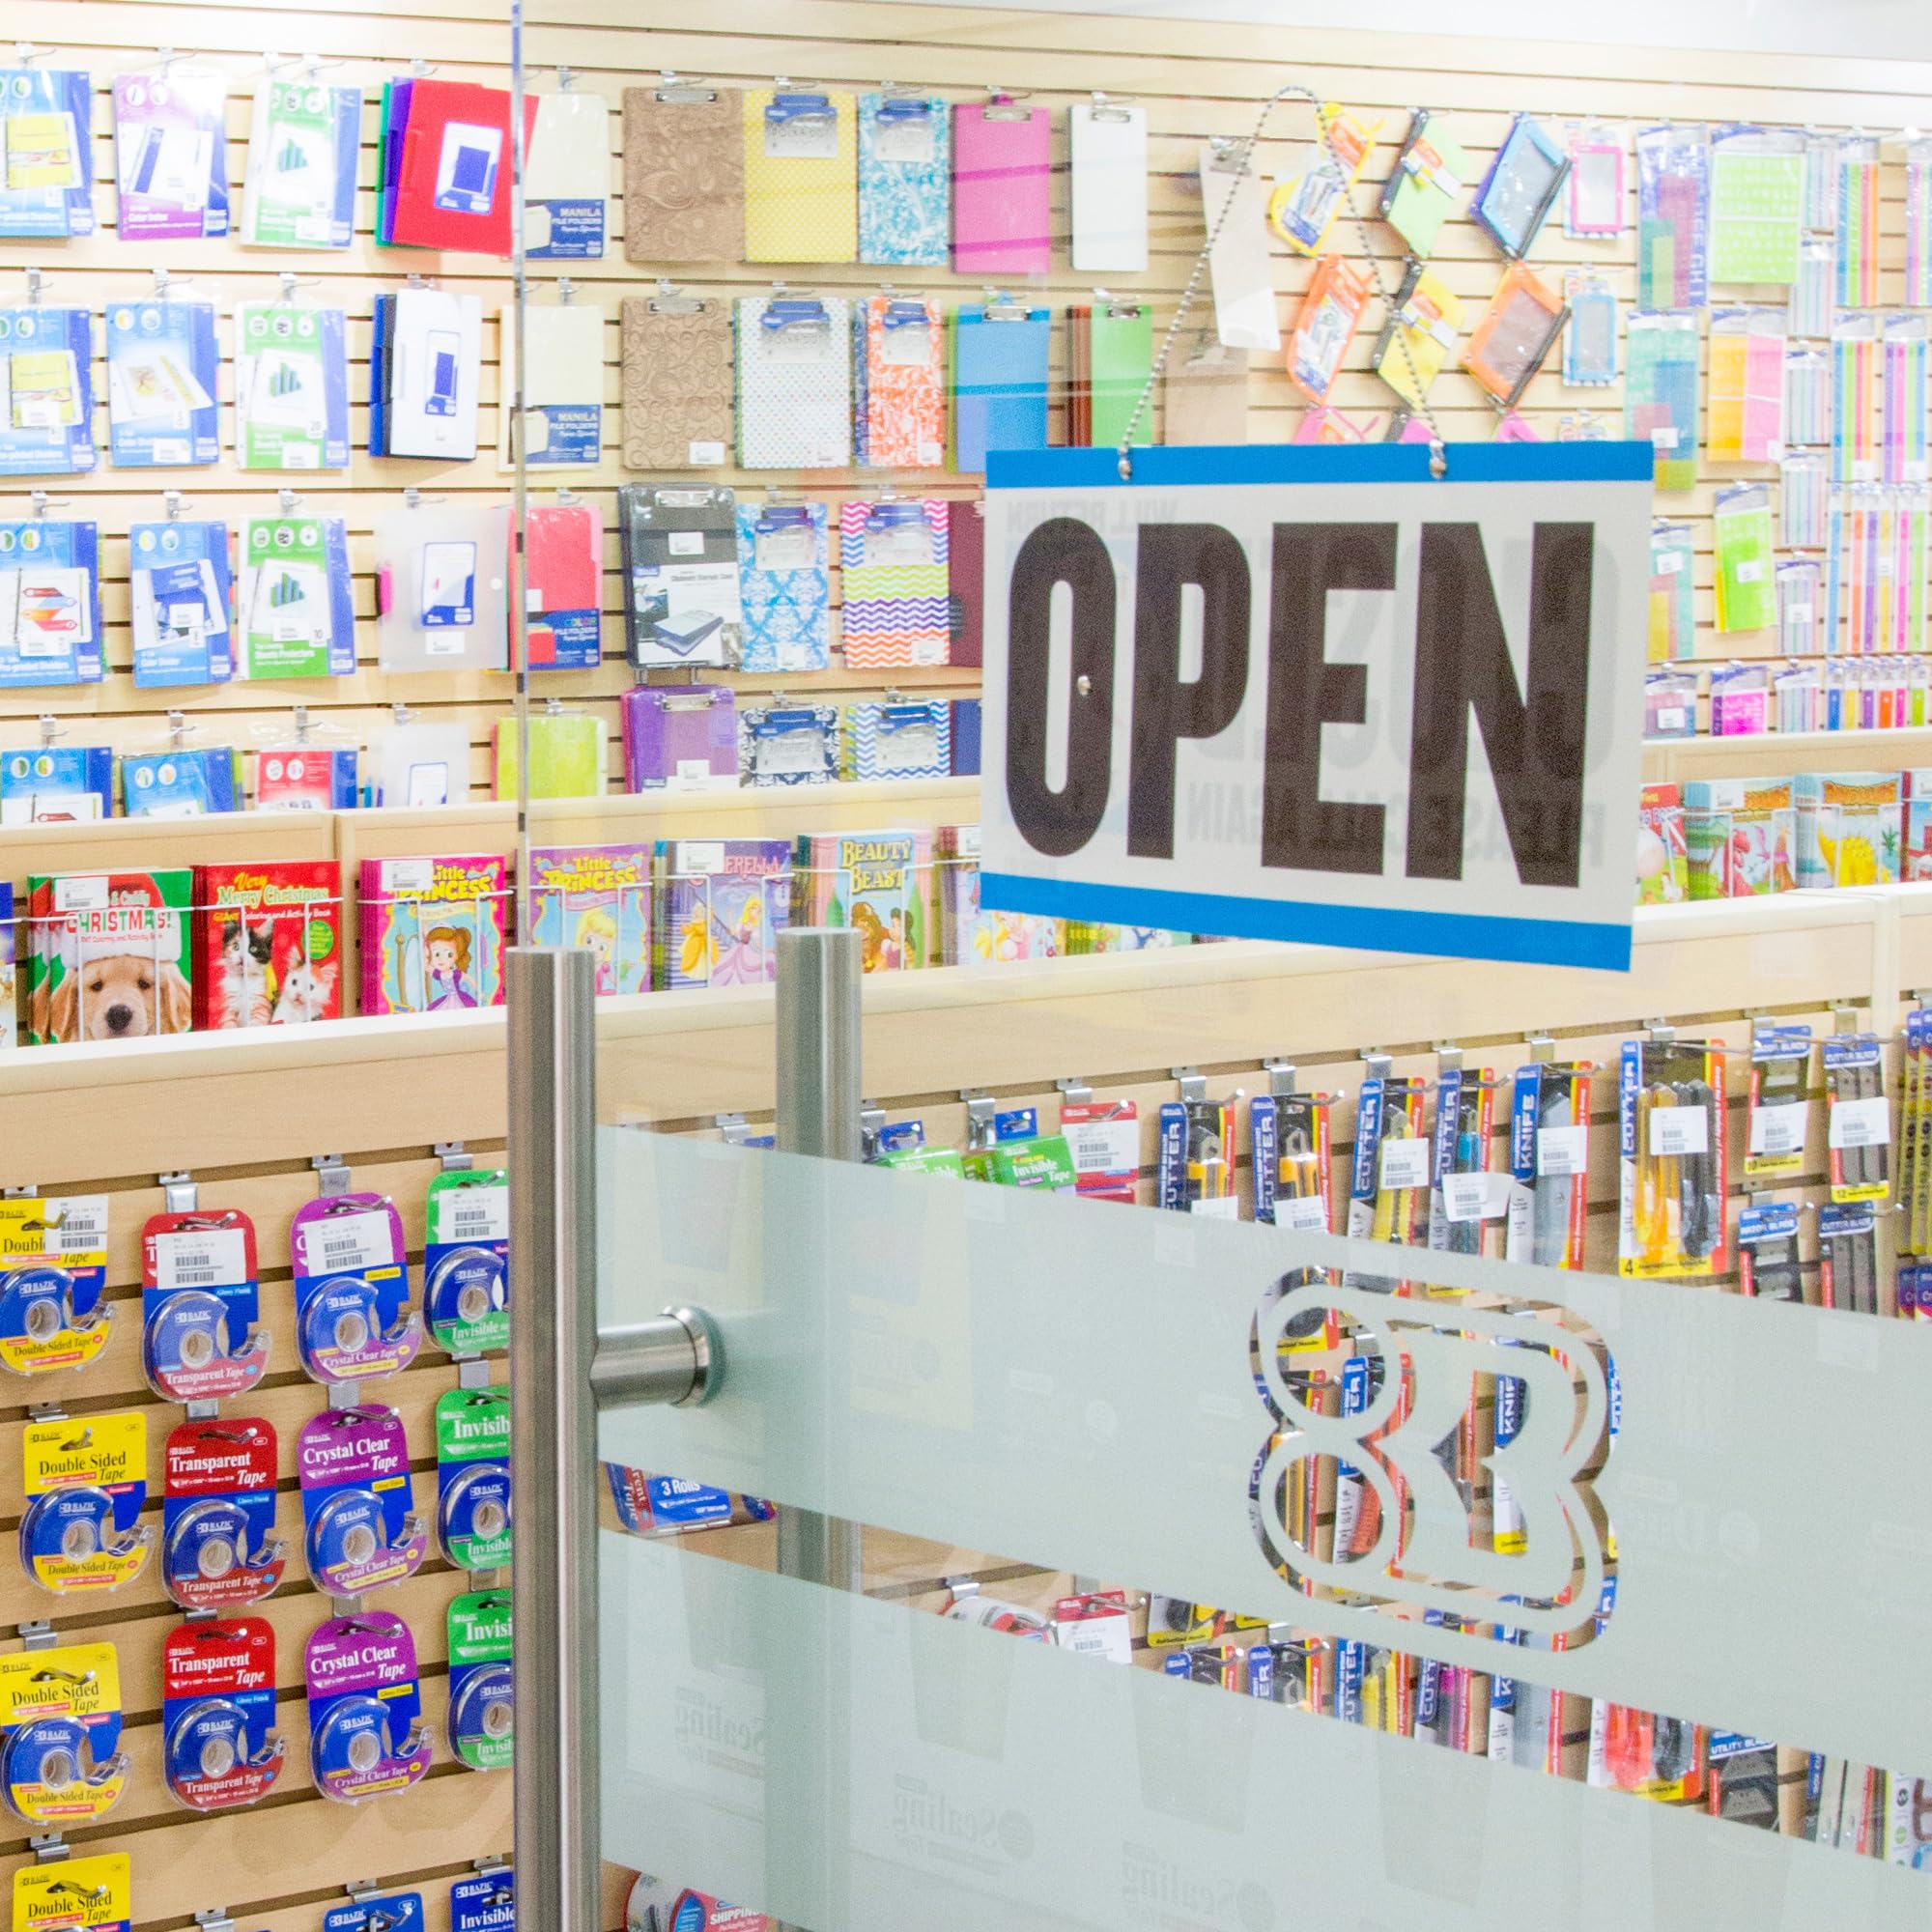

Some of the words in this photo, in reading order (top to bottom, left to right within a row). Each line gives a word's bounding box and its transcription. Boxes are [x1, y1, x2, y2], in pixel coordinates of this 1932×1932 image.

[1007, 517, 1595, 888] OPEN
[842, 840, 912, 868] BEAUTY
[433, 866, 465, 881] Little
[574, 857, 611, 872] Little
[725, 855, 781, 877] ERELLA
[234, 872, 269, 891] Very
[543, 867, 636, 892] PRINCESS
[851, 867, 906, 895] BEAST
[217, 886, 262, 909] Merry
[264, 885, 329, 905] Christmas
[67, 910, 171, 934] CHRISTMAS!
[1520, 1094, 1534, 1169] KNIFE
[1360, 1098, 1377, 1191] CUTTER
[1013, 1158, 1058, 1177] Invisible
[1262, 1116, 1275, 1210] CUTTER
[1049, 1169, 1069, 1182] Tape
[64, 1254, 89, 1265] Tape
[1625, 1259, 1634, 1275] 4
[452, 1321, 499, 1340] Invisible
[14, 1344, 47, 1357] Double
[49, 1340, 73, 1353] Sided
[75, 1339, 92, 1351] Tape
[322, 1353, 355, 1367] Crystal
[355, 1350, 380, 1363] Clear
[381, 1350, 398, 1360] Tape
[166, 1369, 224, 1385] Transparent
[226, 1367, 244, 1379] Tape
[1505, 1377, 1515, 1435] KNIF
[454, 1415, 511, 1439] Invisib
[303, 1442, 353, 1465] Crystal
[355, 1437, 390, 1456] Clear
[40, 1458, 86, 1475] Double
[90, 1451, 127, 1467] Sided
[170, 1454, 251, 1473] Transparent
[372, 1455, 399, 1472] Tape
[99, 1468, 127, 1482] Tape
[238, 1470, 268, 1488] Tape
[661, 1482, 671, 1496] 3
[672, 1479, 700, 1494] Rolls
[48, 1563, 79, 1576] Double
[81, 1561, 106, 1574] Sided
[108, 1559, 126, 1572] Tape
[335, 1567, 365, 1583] Crystal
[366, 1560, 387, 1575] Clear
[388, 1554, 406, 1568] Tape
[182, 1578, 241, 1594] Transparent
[242, 1576, 262, 1588] Tape
[466, 1618, 513, 1642] Invisi
[169, 1652, 250, 1675] Transparent
[311, 1651, 358, 1675] Crystal
[362, 1646, 398, 1663] Clear
[237, 1669, 266, 1688] Tape
[378, 1663, 407, 1681] Tape
[13, 1689, 59, 1707] Double
[62, 1681, 99, 1699] Sided
[73, 1698, 99, 1712] Tape
[1711, 1740, 1743, 1755] UTILITY
[185, 1778, 242, 1795] Transparent
[244, 1776, 263, 1788] Tape
[335, 1774, 366, 1789] Crystal
[368, 1769, 390, 1781] Clear
[391, 1766, 409, 1777] Tape
[27, 1792, 58, 1804] Double
[60, 1790, 84, 1803] Sided
[86, 1790, 104, 1802] Tape
[28, 1899, 73, 1918] Double
[77, 1892, 112, 1910] Sided
[88, 1908, 112, 1923] Tape
